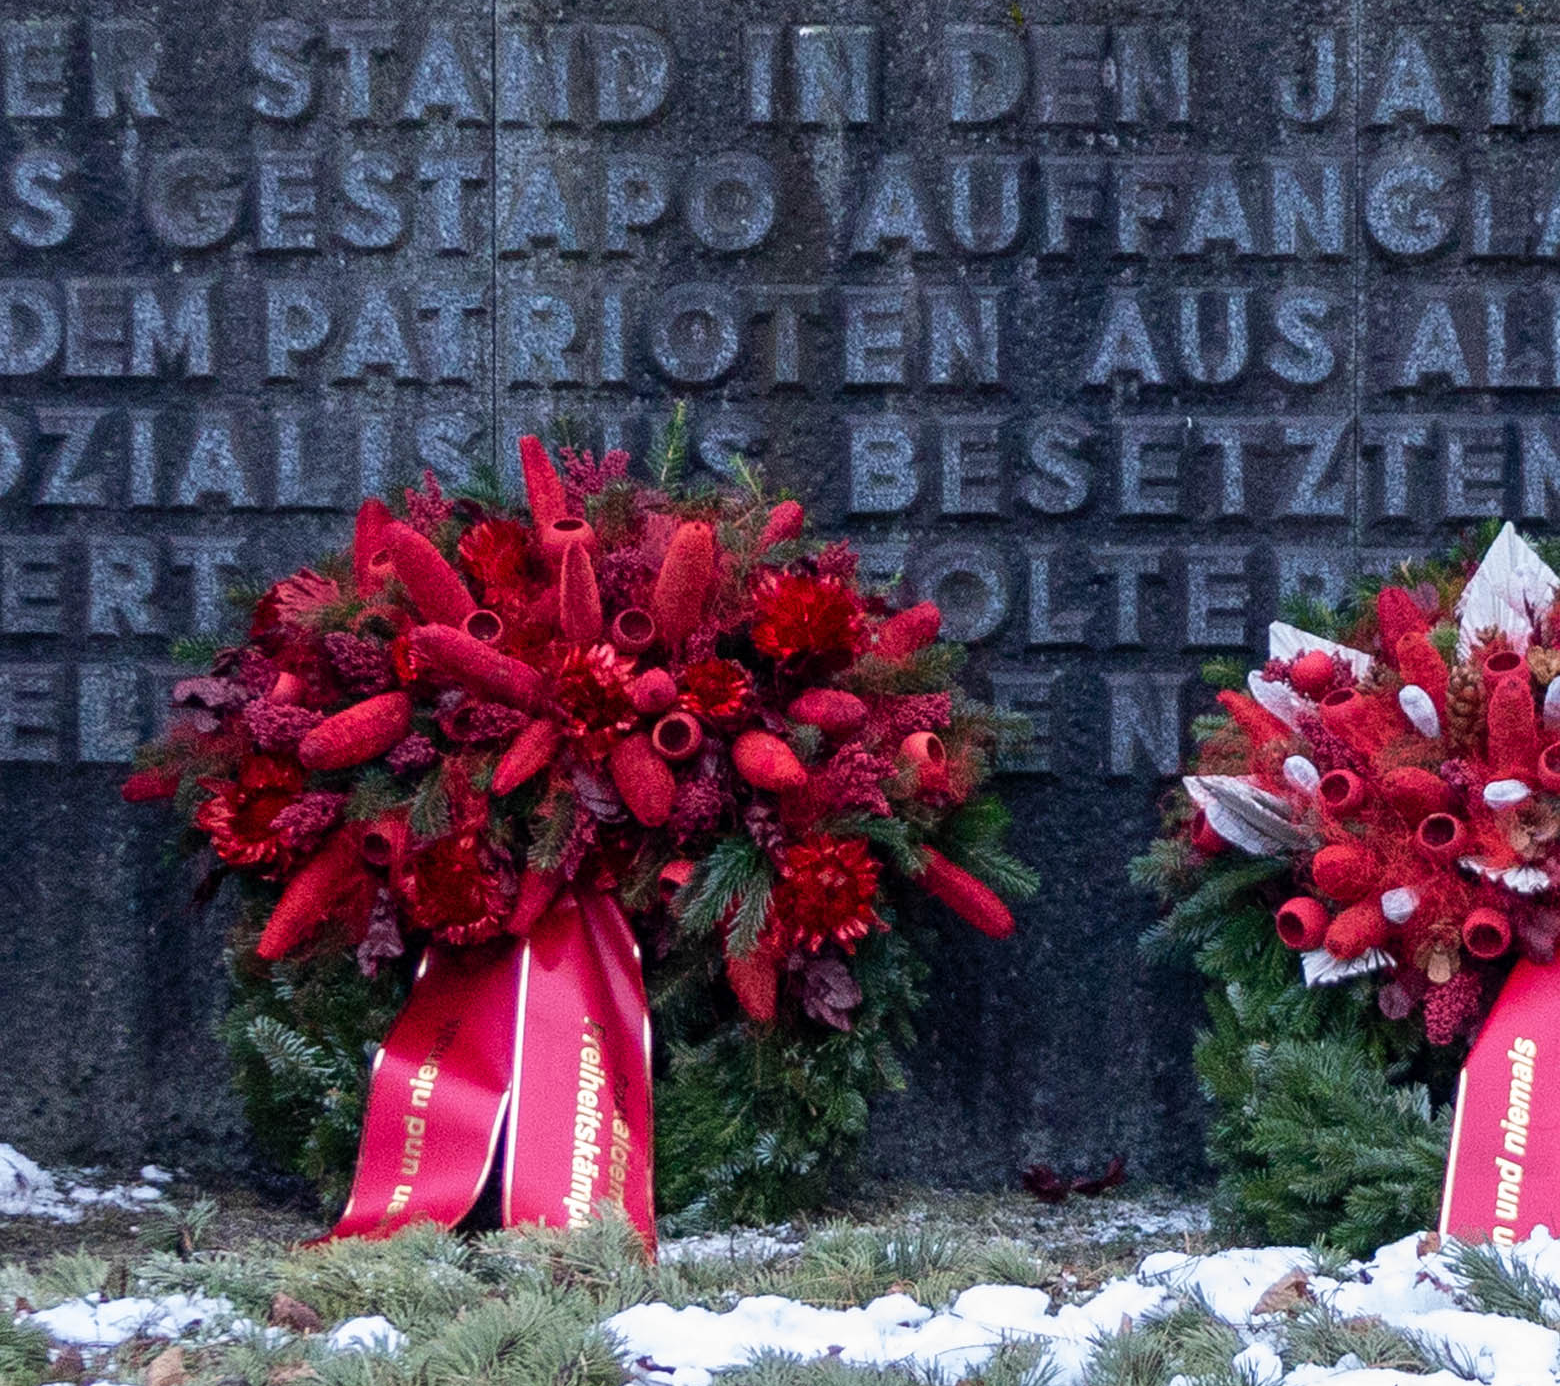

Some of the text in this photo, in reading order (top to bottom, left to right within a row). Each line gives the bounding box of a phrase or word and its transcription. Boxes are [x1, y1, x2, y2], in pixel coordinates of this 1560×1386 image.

[246, 21, 673, 124] STAND
[743, 23, 878, 124] IN
[940, 23, 1191, 124] DEN
[146, 148, 777, 252] GESTAPO
[263, 280, 1000, 387] PATRIOTEN
[1083, 284, 1338, 389] AUS
[400, 1113, 427, 1176] und
[1497, 1036, 1538, 1157] niemals
[1490, 1156, 1525, 1221] und
